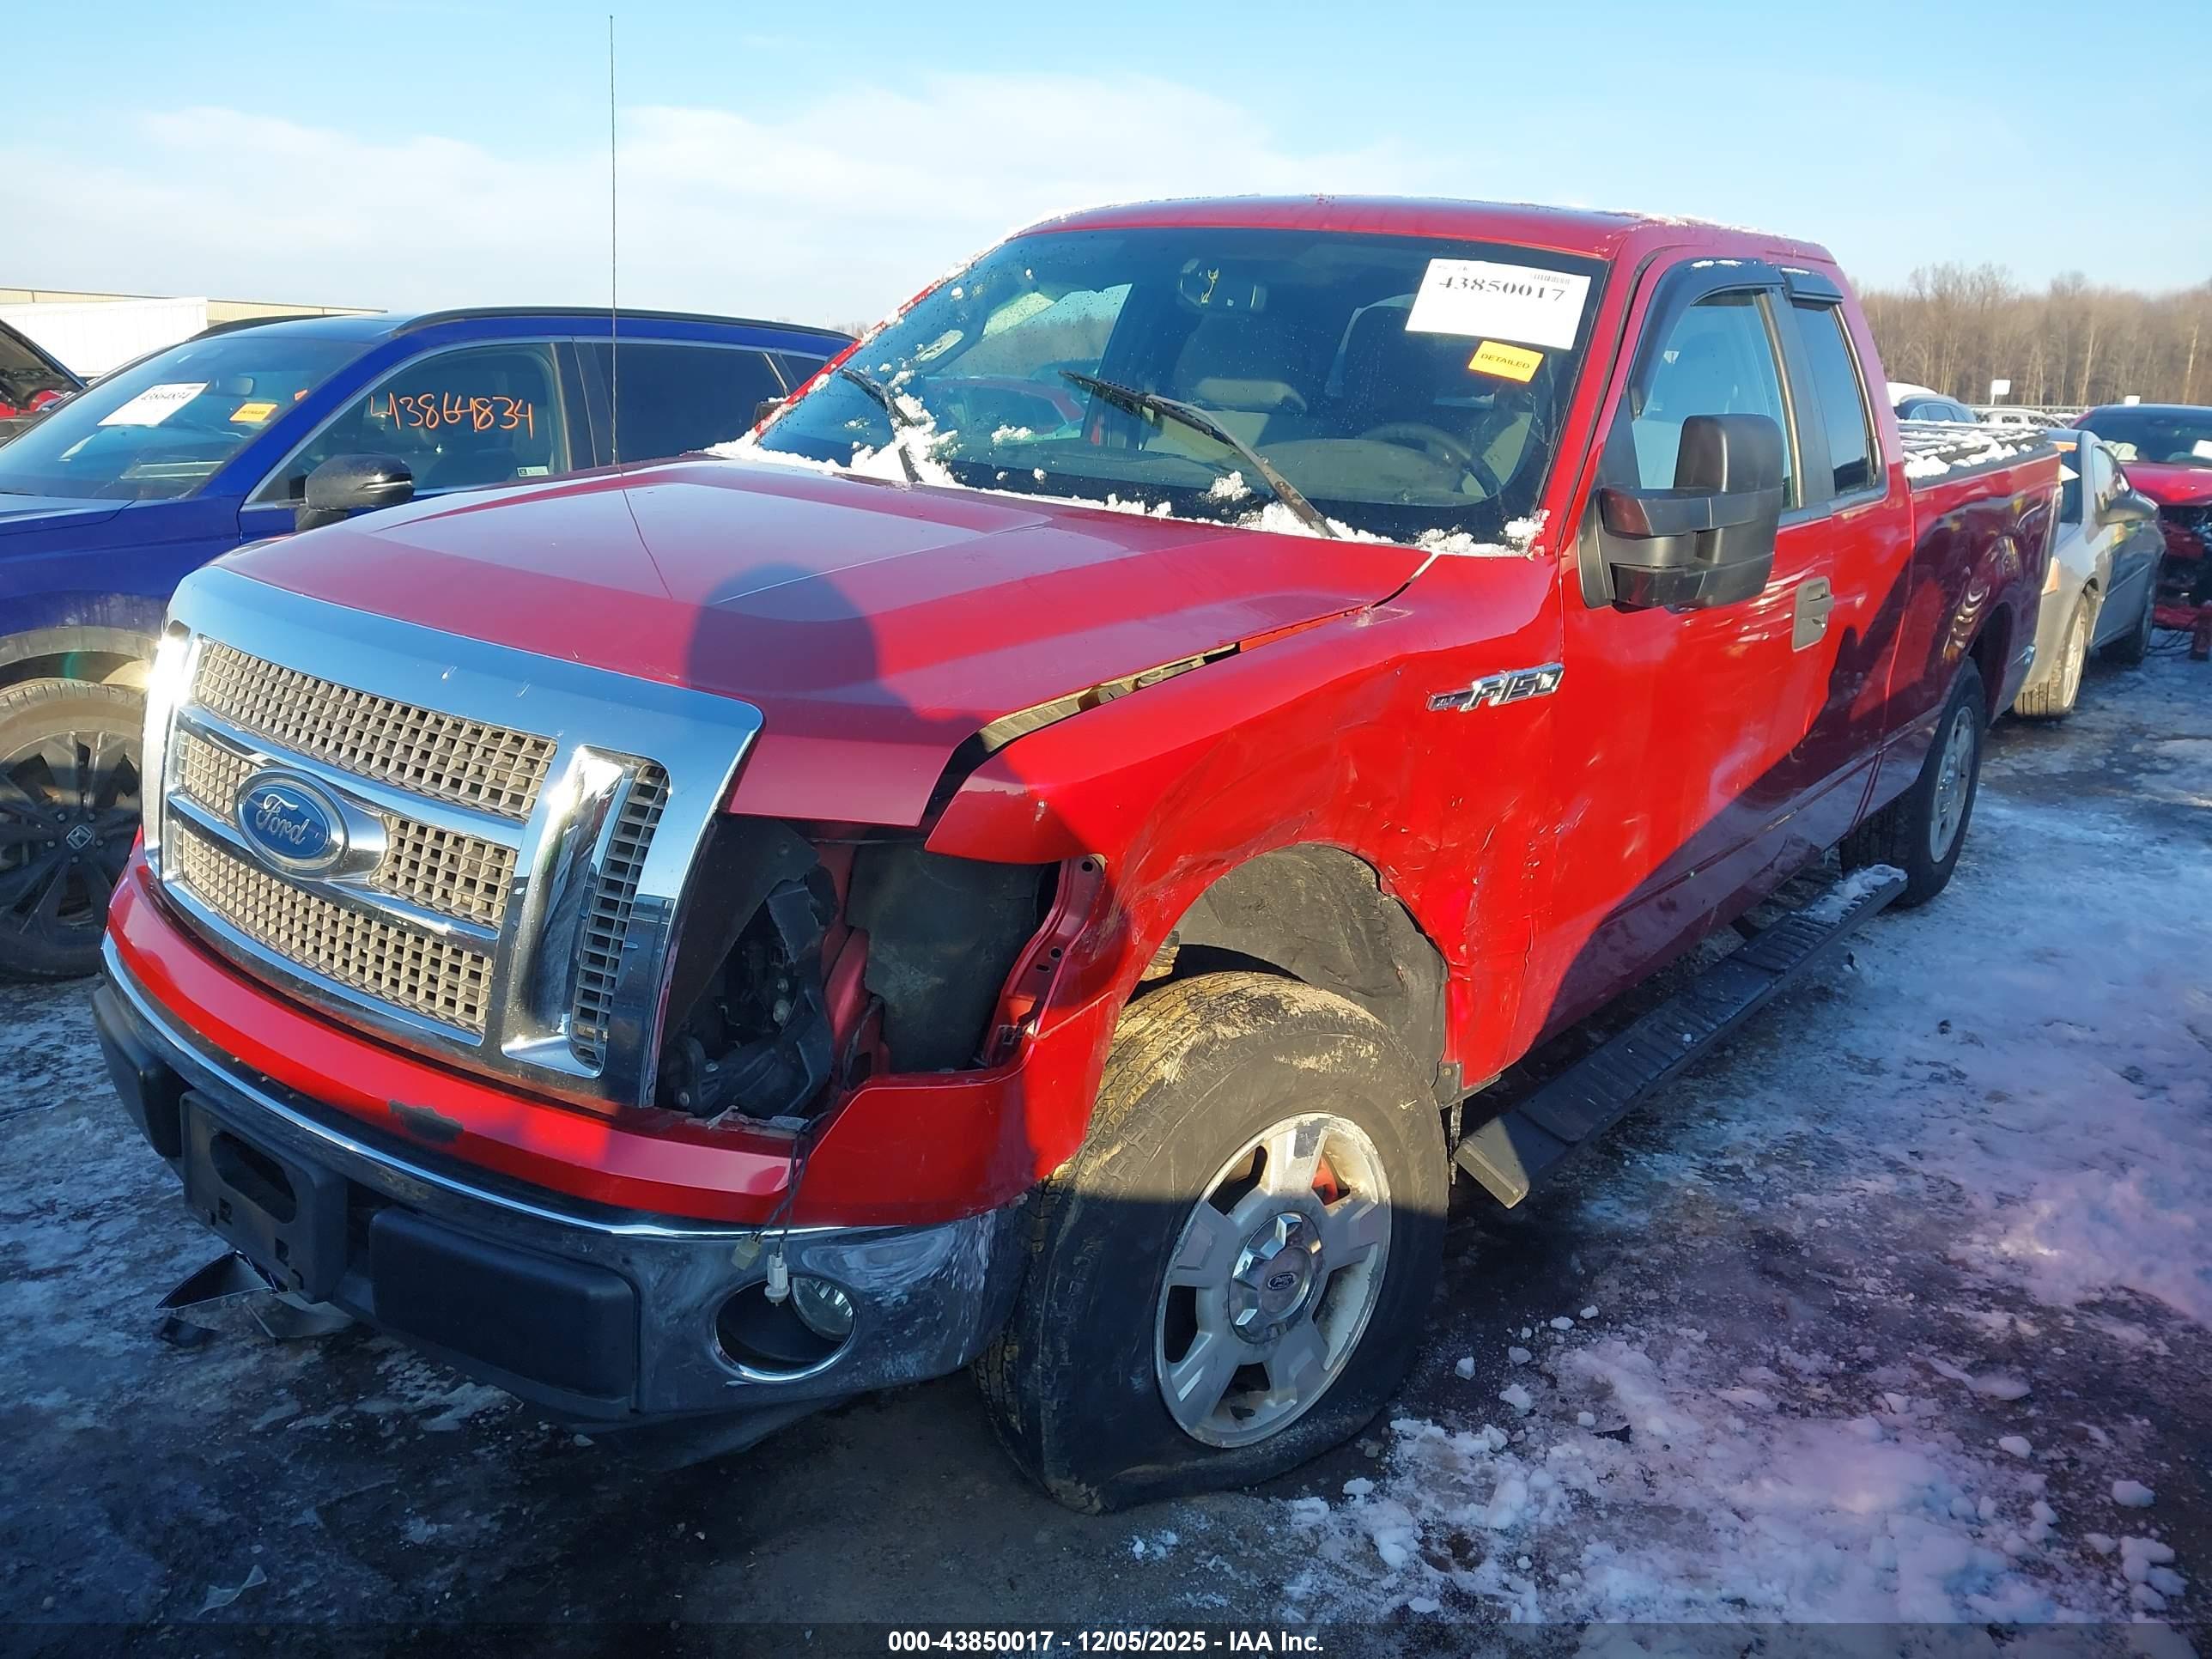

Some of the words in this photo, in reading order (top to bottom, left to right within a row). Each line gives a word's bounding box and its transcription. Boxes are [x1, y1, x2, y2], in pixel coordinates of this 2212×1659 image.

[1438, 276, 1565, 301] 43850017
[1480, 353, 1530, 370] DETAILED
[370, 392, 533, 440] 43864834
[255, 793, 310, 846] Ford
